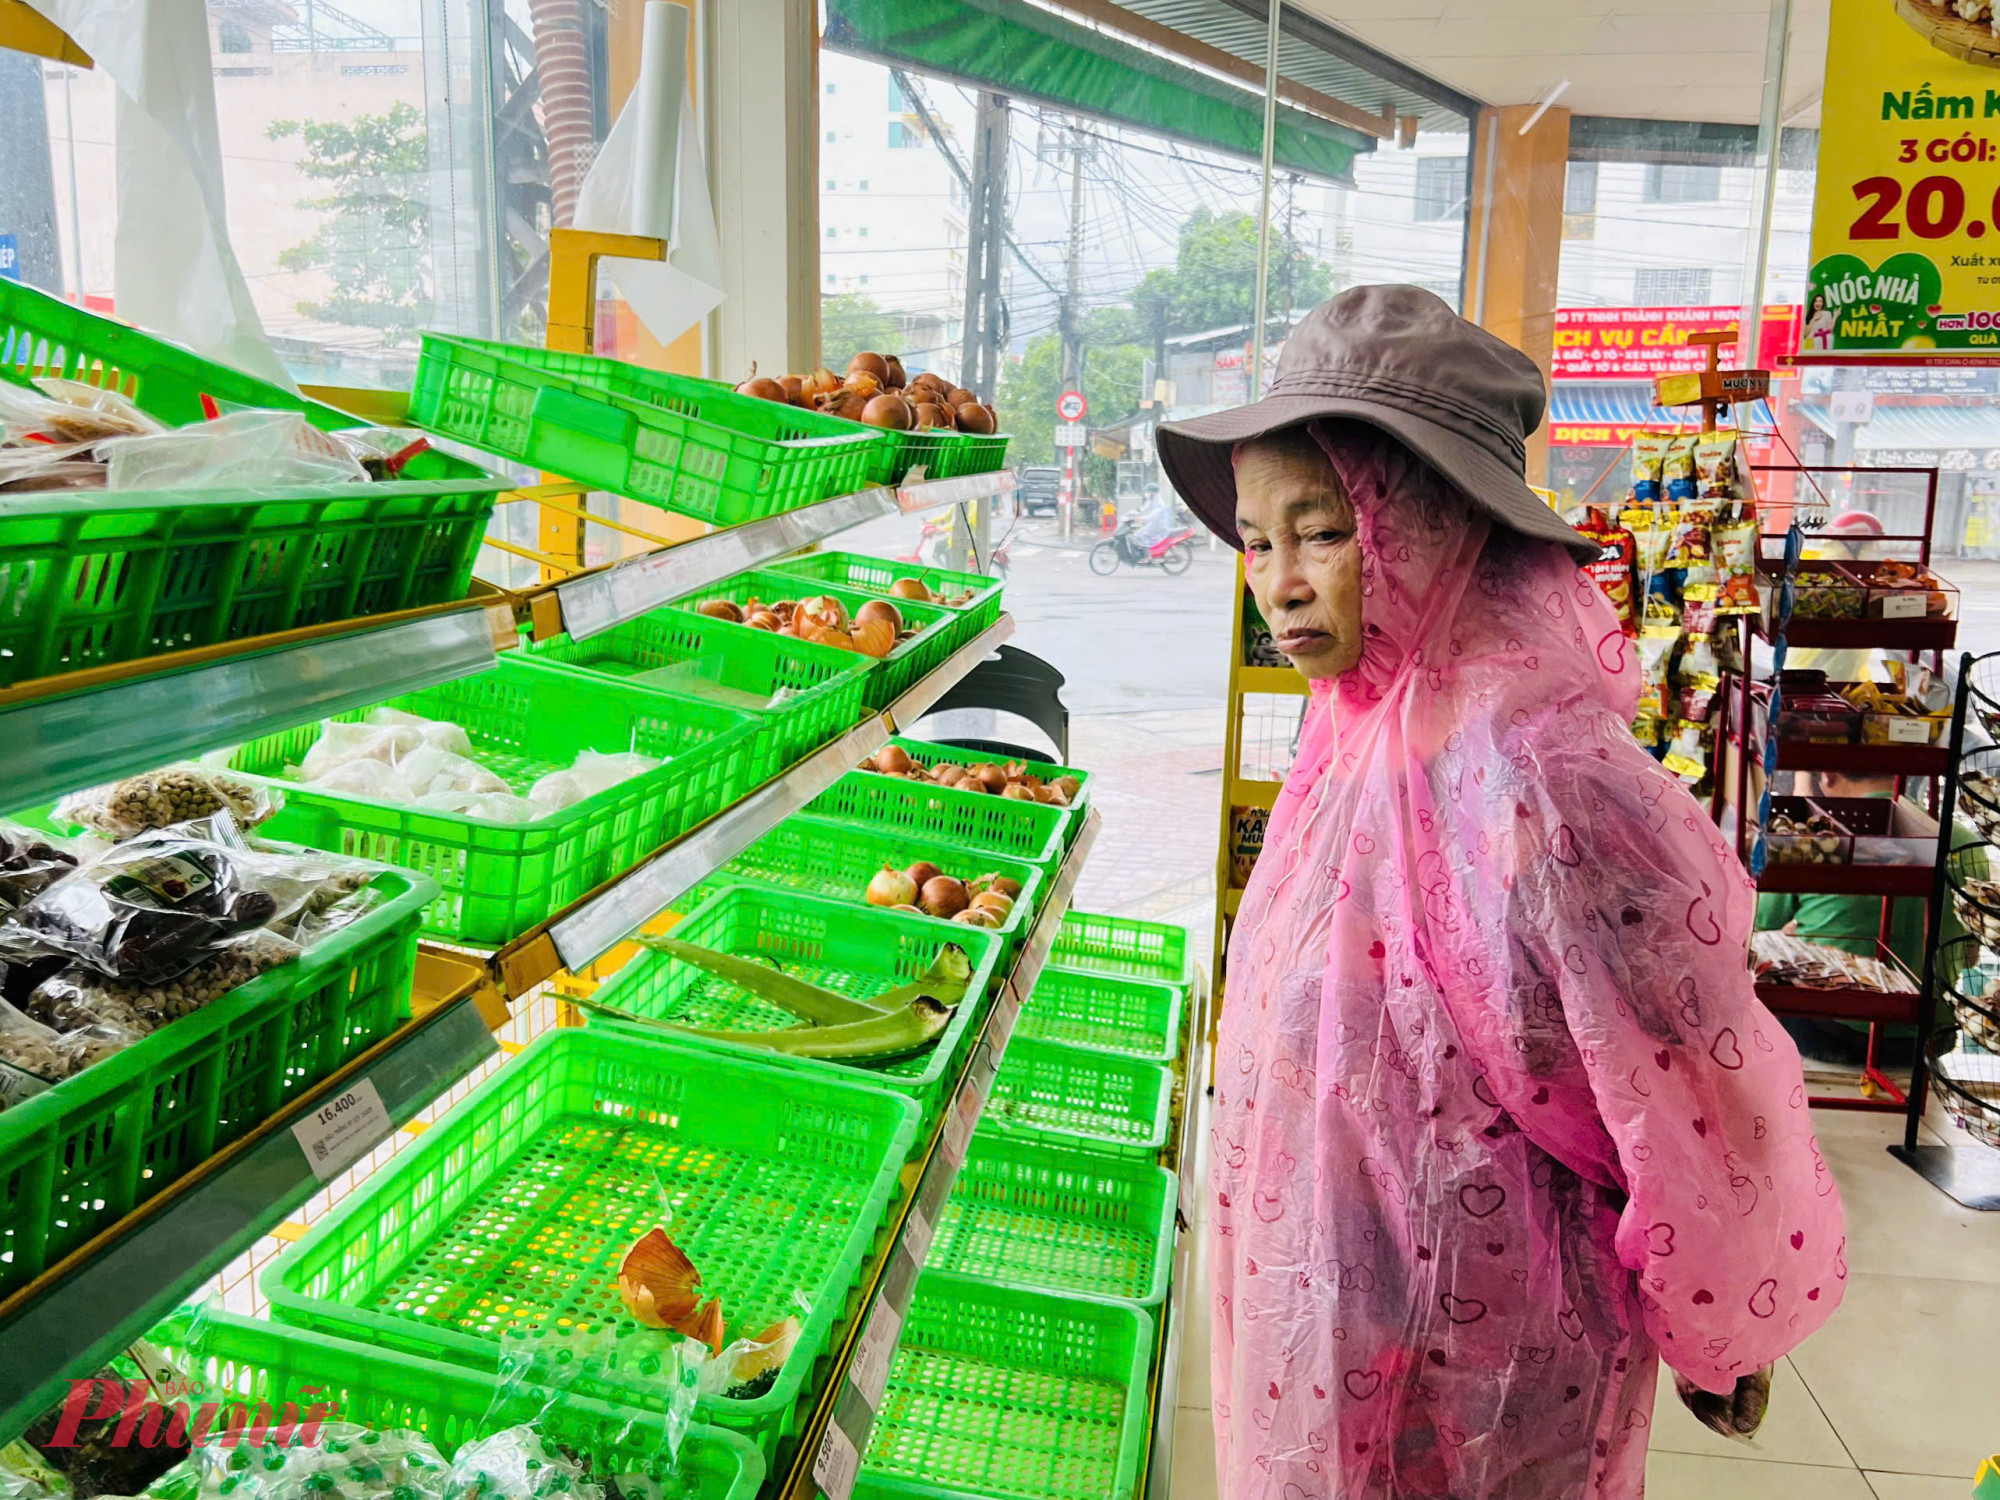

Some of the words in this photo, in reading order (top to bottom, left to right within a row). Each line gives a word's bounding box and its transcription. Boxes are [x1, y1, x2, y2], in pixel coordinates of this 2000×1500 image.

[1881, 82, 1974, 120] Nấm
[1898, 139, 1918, 163] 3
[1926, 131, 1996, 162] GÓI:
[1849, 175, 2000, 240] 20.
[1950, 254, 1984, 267] Xuất
[1824, 272, 1872, 308] NÓC
[1874, 273, 1919, 305] NHÀ
[1841, 312, 1904, 337] NHẤT
[1851, 304, 1868, 318] LÀ
[1600, 329, 1634, 349] VỤ
[1969, 333, 1998, 344] QUÀ
[1555, 428, 1610, 443] DỊCH
[318, 1094, 356, 1125] 16.400
[818, 1430, 834, 1473] 9.500
